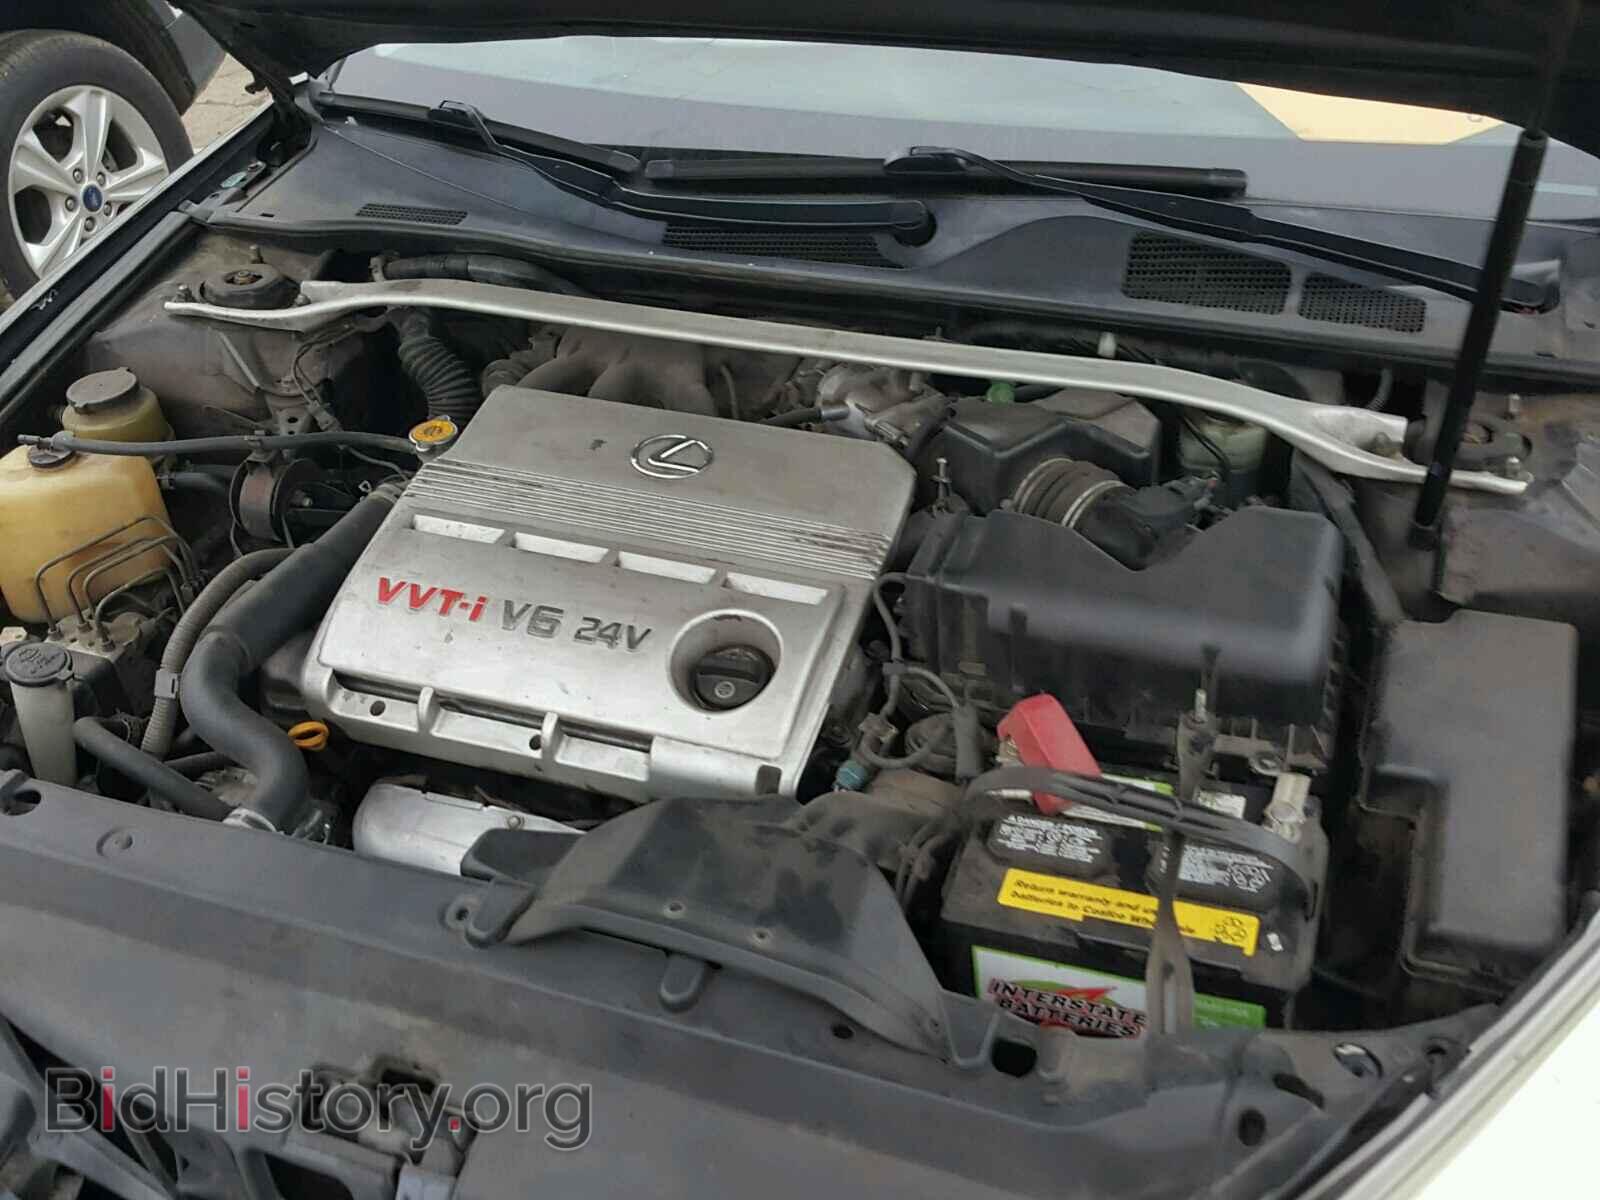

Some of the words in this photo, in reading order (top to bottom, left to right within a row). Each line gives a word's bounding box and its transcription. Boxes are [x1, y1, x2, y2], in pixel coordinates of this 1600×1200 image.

[377, 576, 489, 622] VVT-i
[501, 599, 564, 639] V6
[573, 616, 653, 650] 24V
[989, 980, 1146, 1025] INTERSTATE
[998, 999, 1142, 1039] BATTERIES
